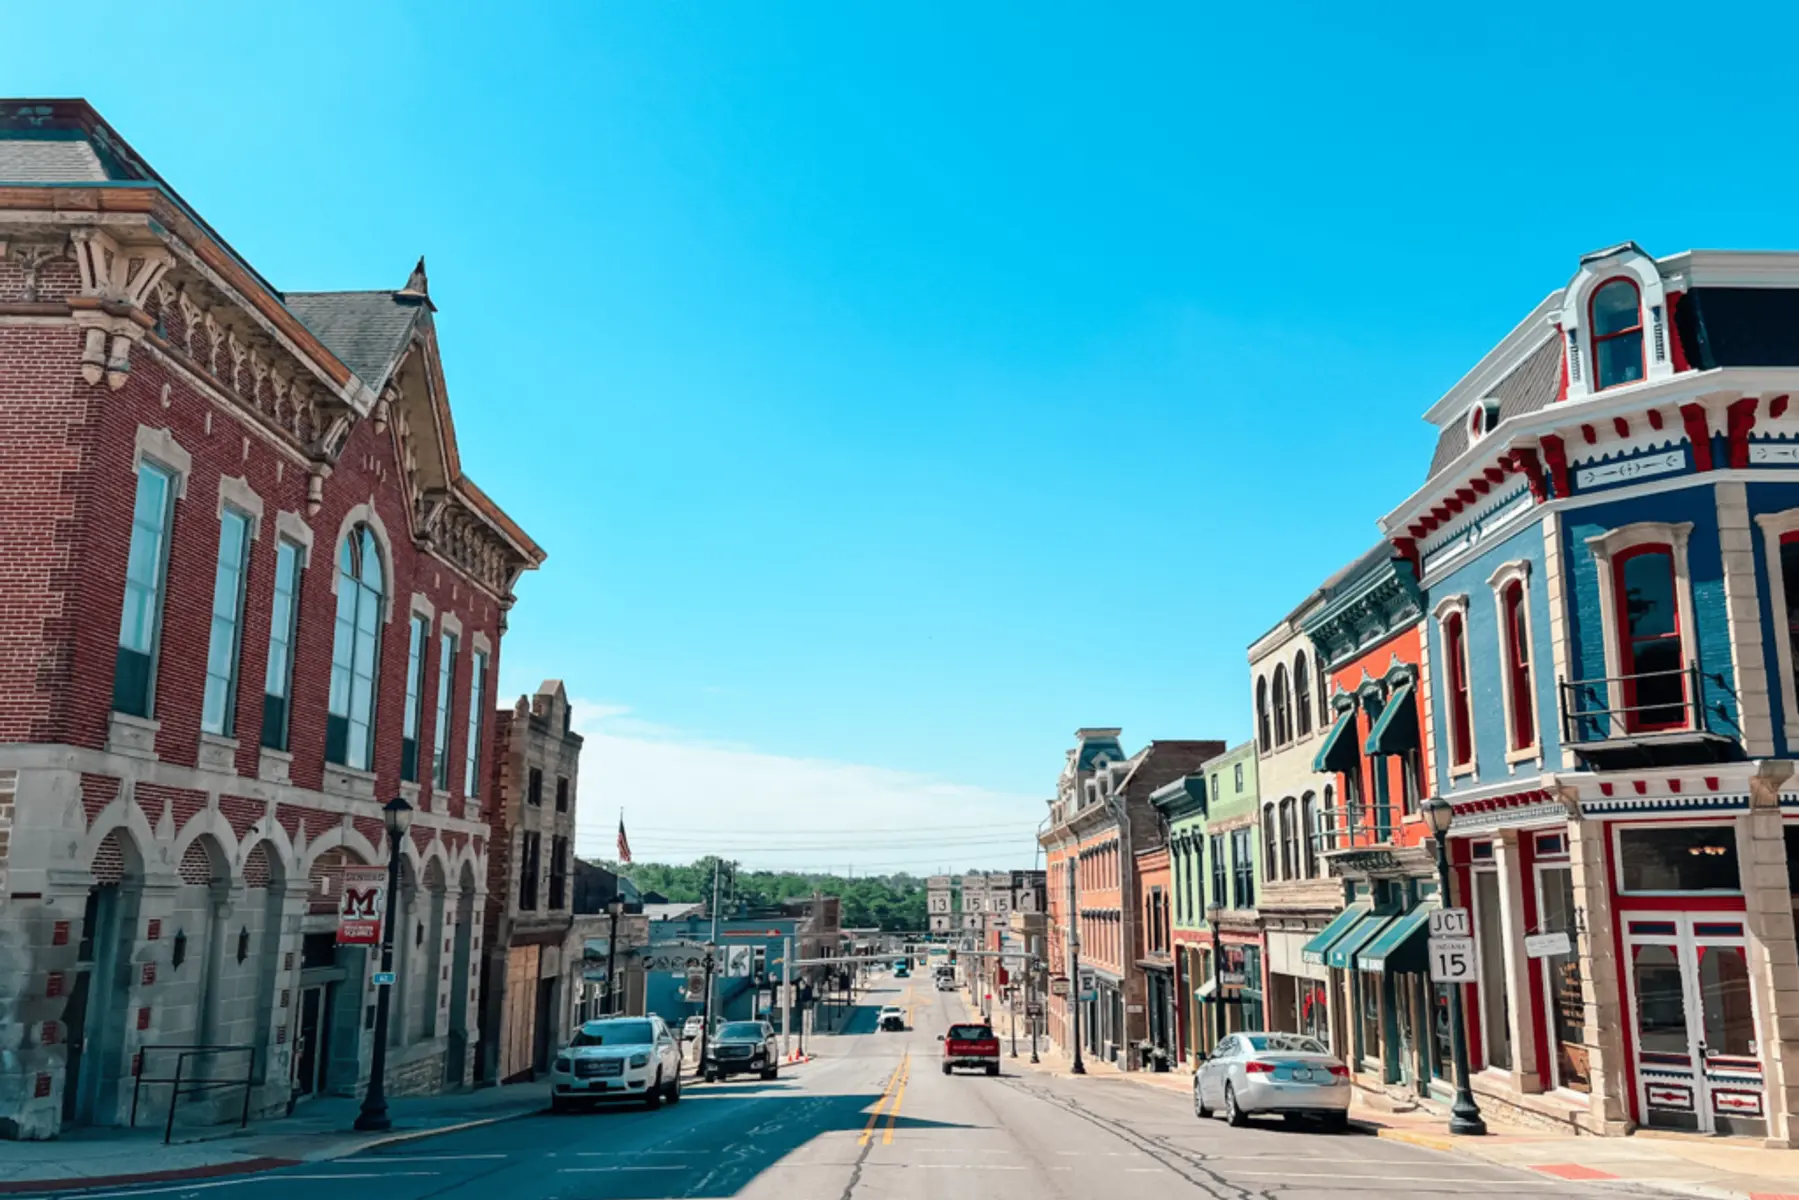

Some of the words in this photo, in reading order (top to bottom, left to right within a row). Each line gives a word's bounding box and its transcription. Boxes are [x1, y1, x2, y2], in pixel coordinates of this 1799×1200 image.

[342, 887, 381, 919] M
[932, 898, 947, 912] 13
[966, 898, 980, 911] 15
[993, 898, 1008, 911] 15
[1433, 913, 1464, 932] JCT
[1439, 953, 1467, 977] 15
